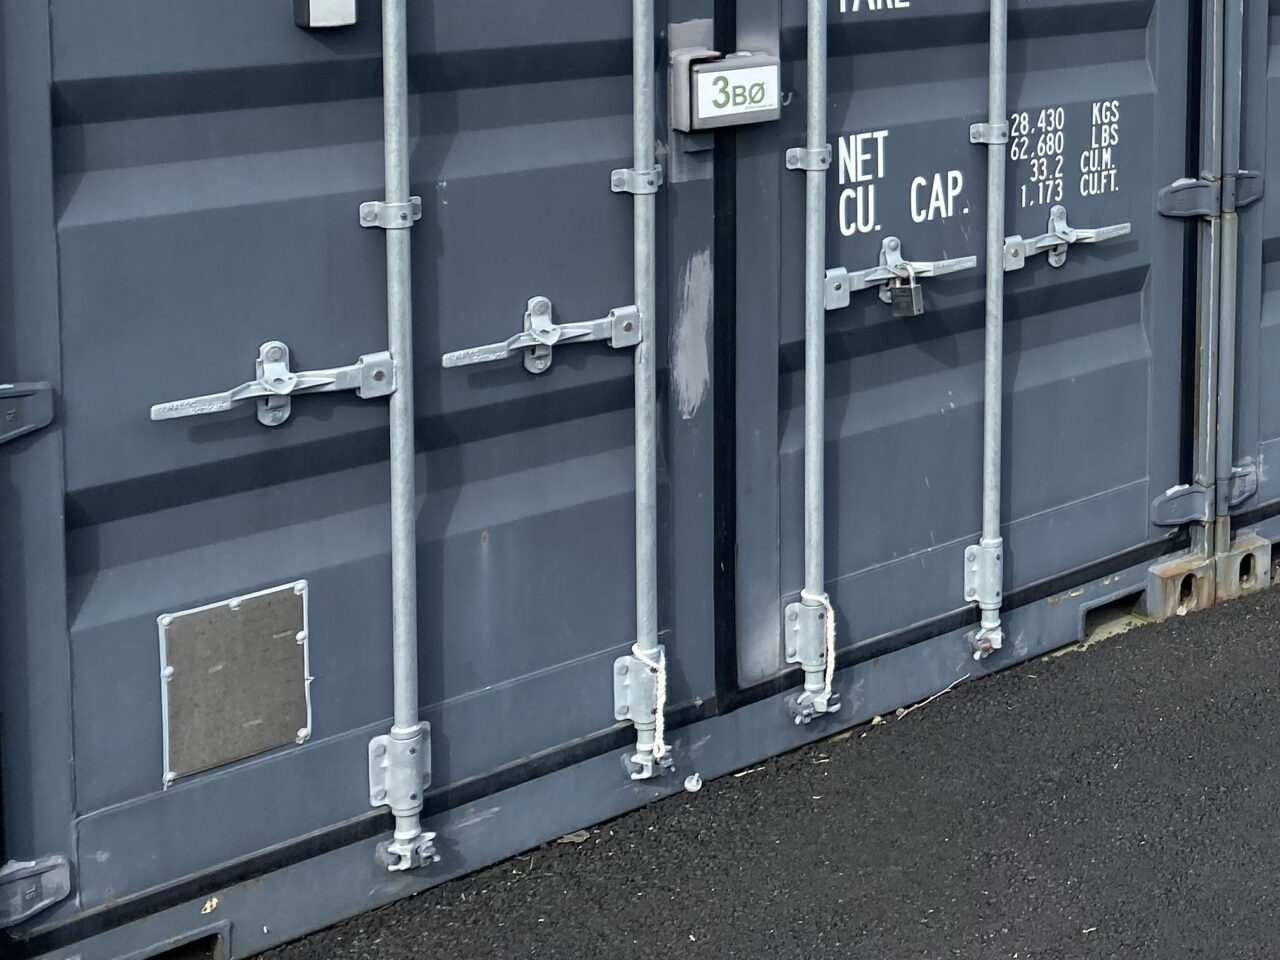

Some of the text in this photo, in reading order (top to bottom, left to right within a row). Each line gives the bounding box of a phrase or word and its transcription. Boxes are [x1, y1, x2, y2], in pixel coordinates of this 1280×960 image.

[1092, 100, 1120, 125] KGS
[1091, 123, 1119, 149] LBS
[838, 129, 889, 185] NET
[1029, 147, 1115, 182] 33.2 CU.M.
[1080, 169, 1119, 197] CU.FT.
[838, 169, 969, 236] CU. CAP.
